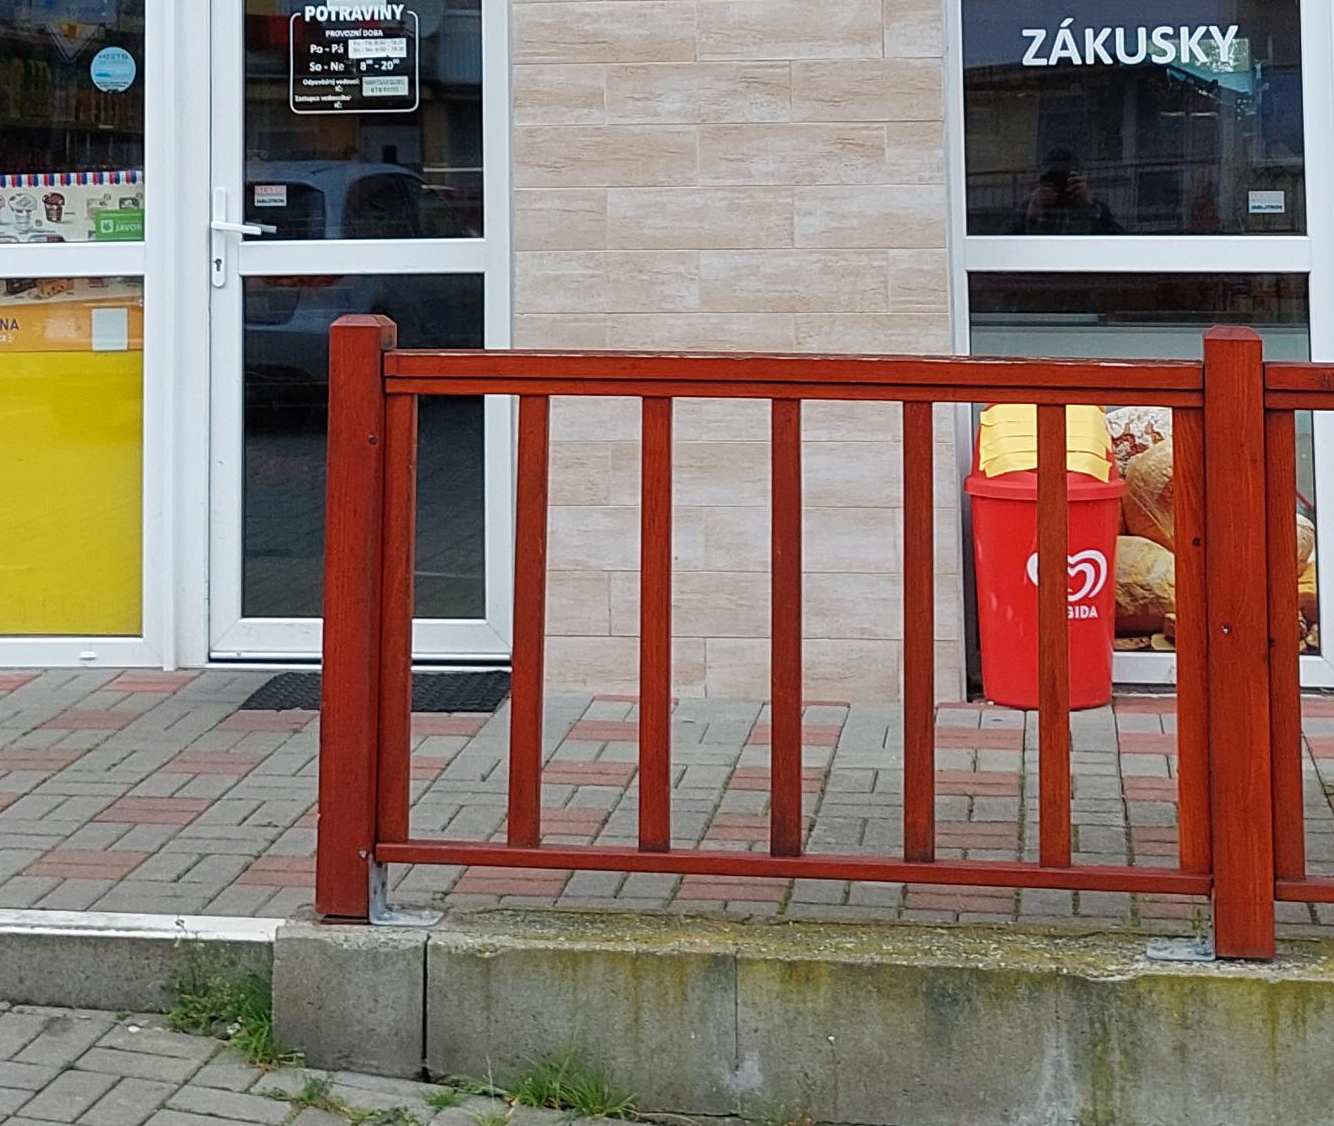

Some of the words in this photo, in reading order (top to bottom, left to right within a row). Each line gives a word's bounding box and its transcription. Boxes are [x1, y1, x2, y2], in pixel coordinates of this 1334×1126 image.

[304, 4, 405, 22] POTRAVINY
[325, 29, 362, 38] PROVOZNÍ
[363, 29, 384, 37] DOBA
[1021, 17, 1239, 66] ZÁKUSKY
[309, 44, 323, 54] Po
[331, 43, 344, 54] Pá
[309, 62, 322, 72] So
[330, 62, 345, 72] Ne
[1066, 605, 1099, 619] GIDA
